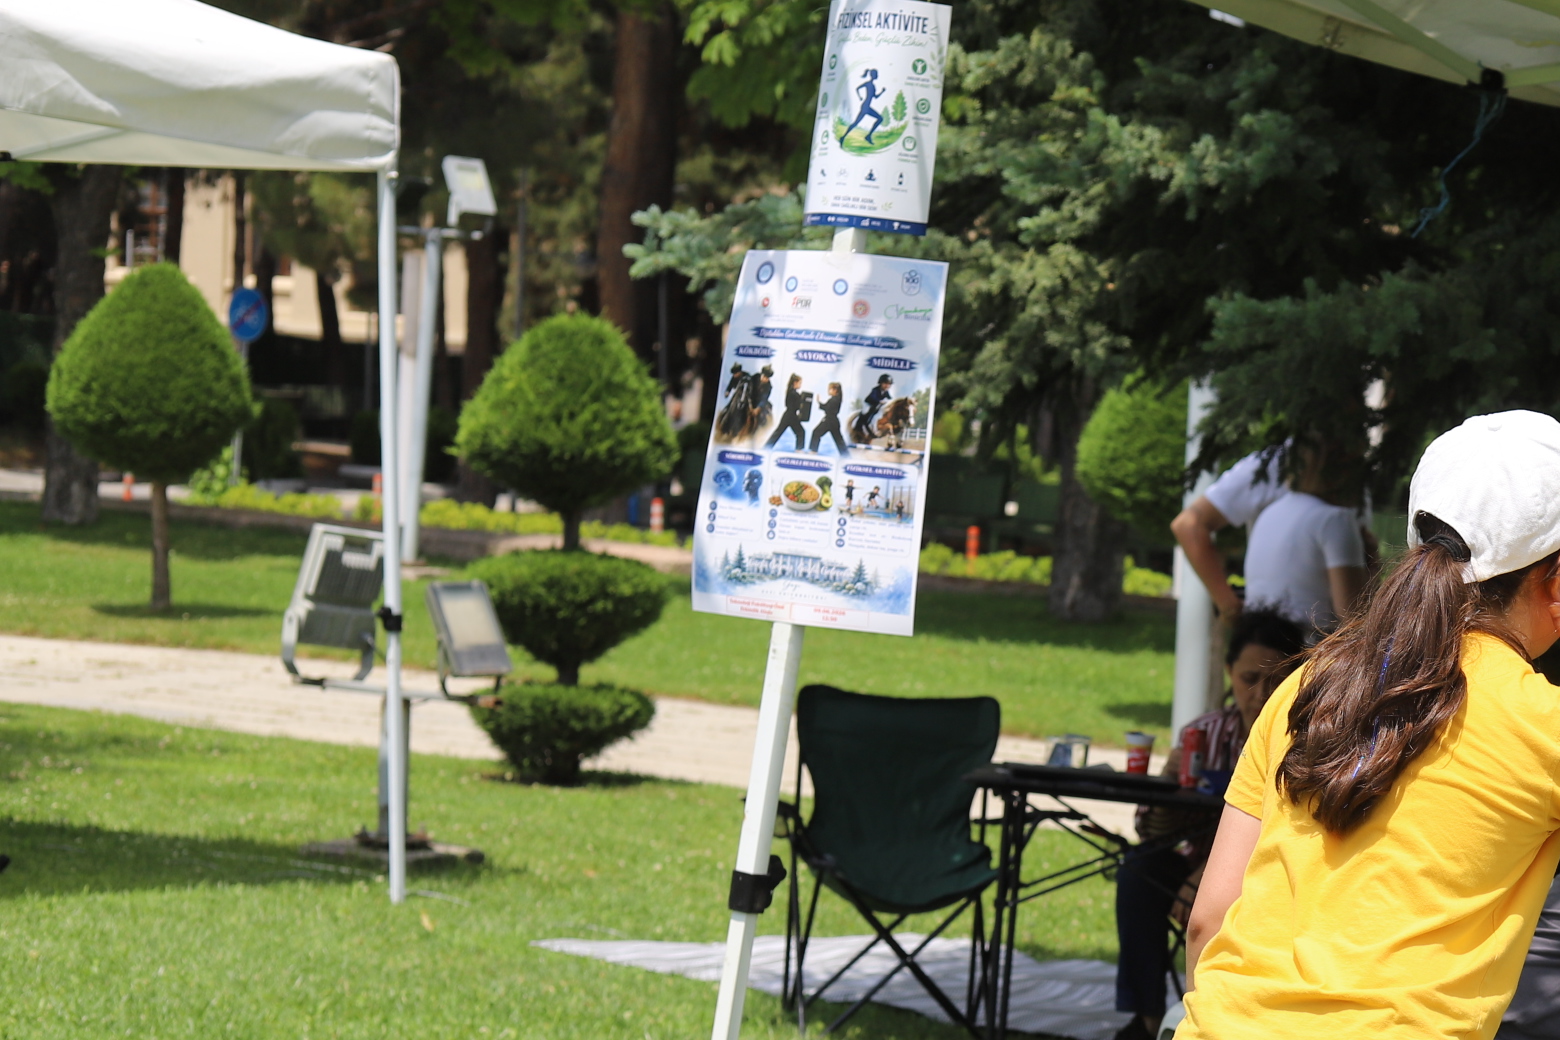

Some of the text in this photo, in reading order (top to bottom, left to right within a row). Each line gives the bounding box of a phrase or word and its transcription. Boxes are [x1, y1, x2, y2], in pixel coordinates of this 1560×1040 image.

[837, 8, 929, 35] FİZİKSEL AKTİVİTE
[872, 357, 911, 370] MİDİLLİ
